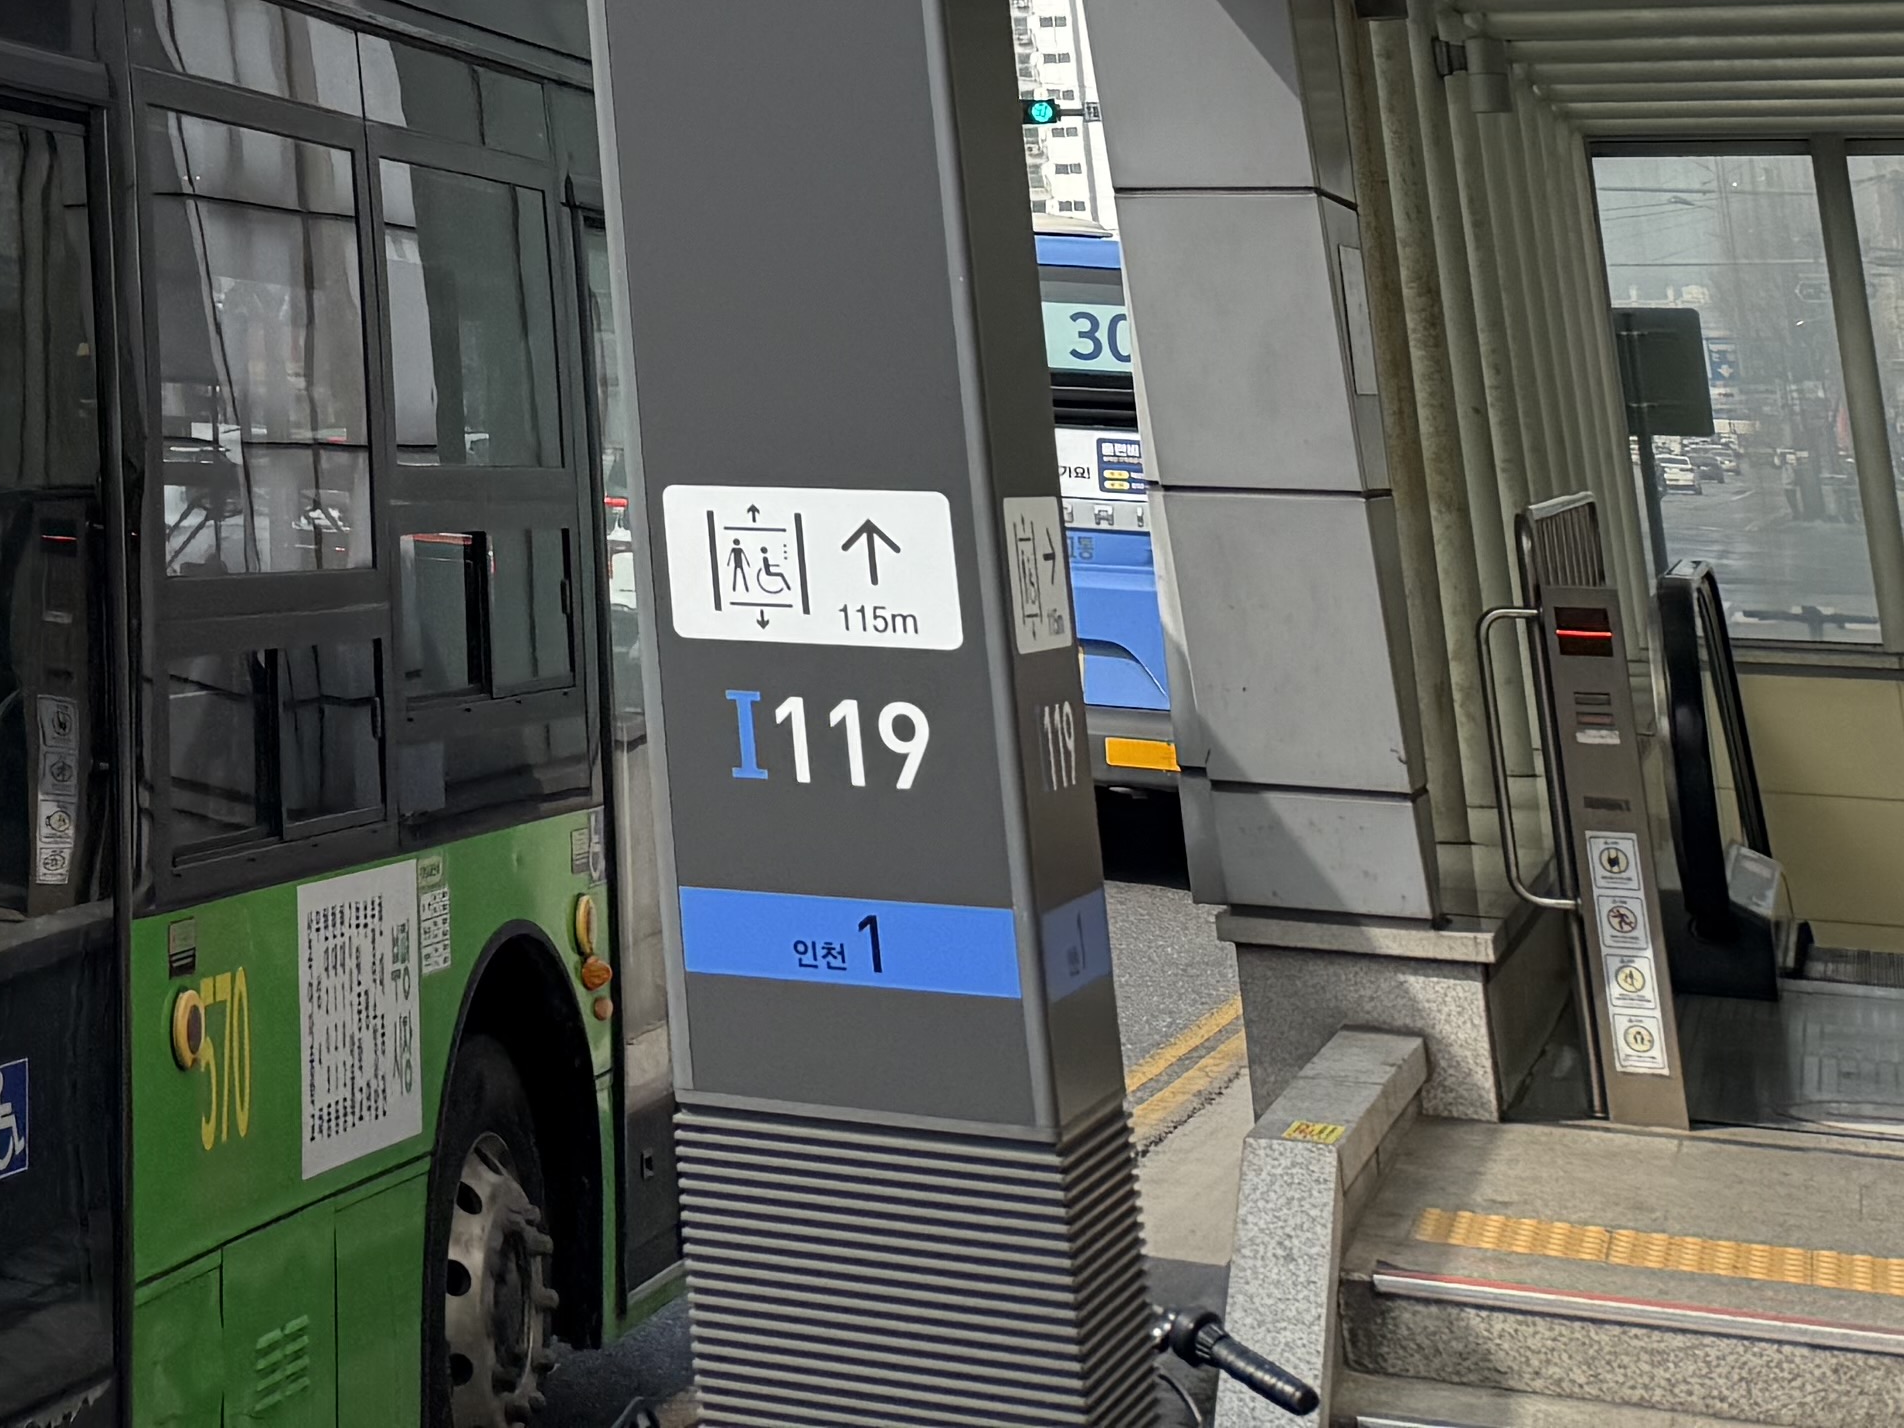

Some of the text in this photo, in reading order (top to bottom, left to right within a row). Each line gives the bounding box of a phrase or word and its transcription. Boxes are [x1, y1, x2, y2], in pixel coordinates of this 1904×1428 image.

[838, 604, 919, 635] 115m
[792, 914, 883, 973] 인천 1
[198, 966, 251, 1151] 570
